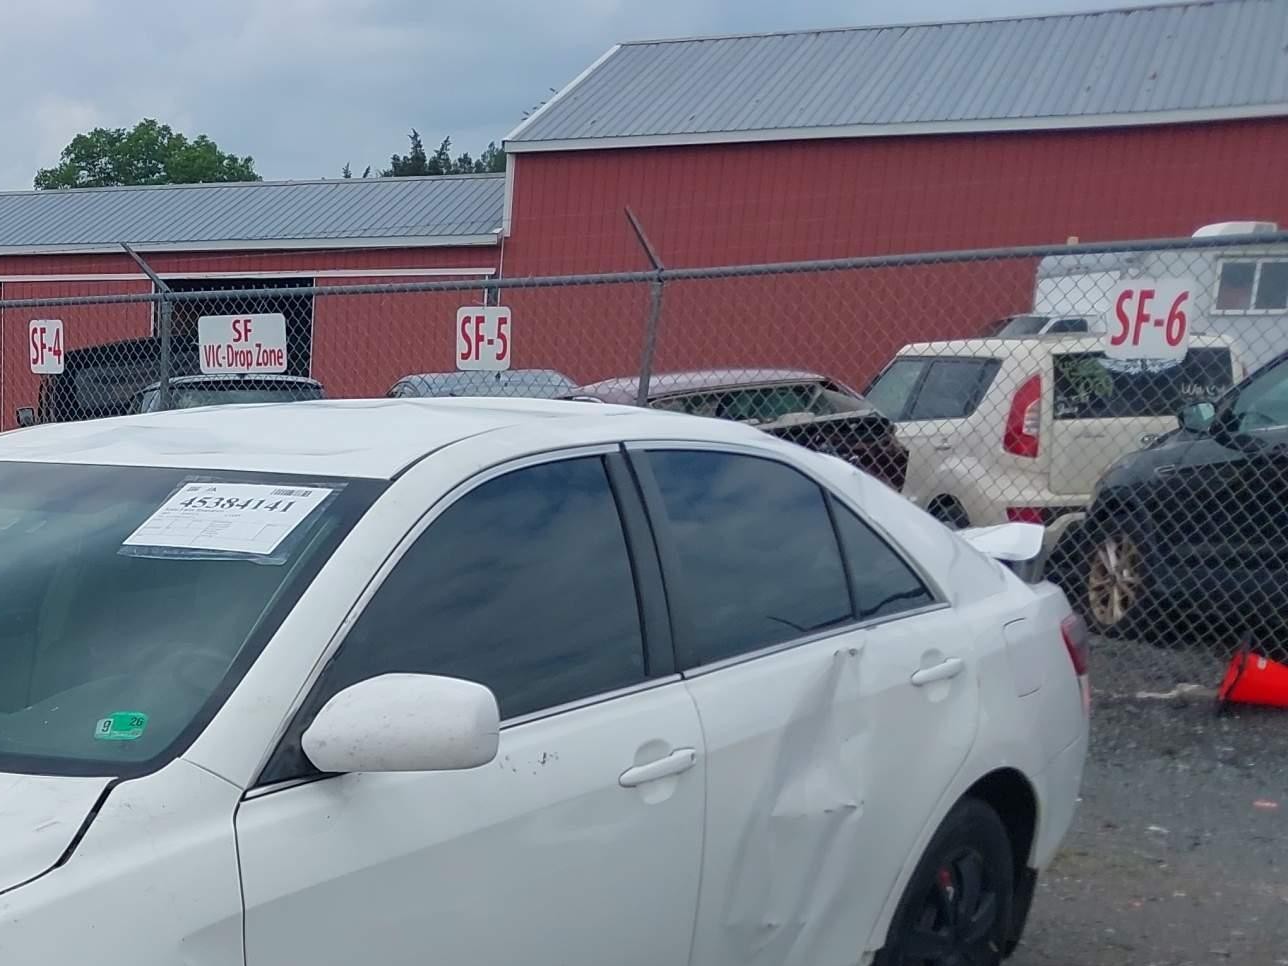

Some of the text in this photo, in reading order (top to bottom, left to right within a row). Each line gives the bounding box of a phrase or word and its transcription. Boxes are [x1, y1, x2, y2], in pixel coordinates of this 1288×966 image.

[231, 319, 252, 343] SF
[1110, 289, 1190, 346] SF-6
[31, 327, 62, 365] SF-4
[460, 315, 508, 361] SF-5
[203, 343, 284, 370] VIC-Drop Zone
[180, 496, 296, 513] 45384141
[129, 717, 144, 727] 26
